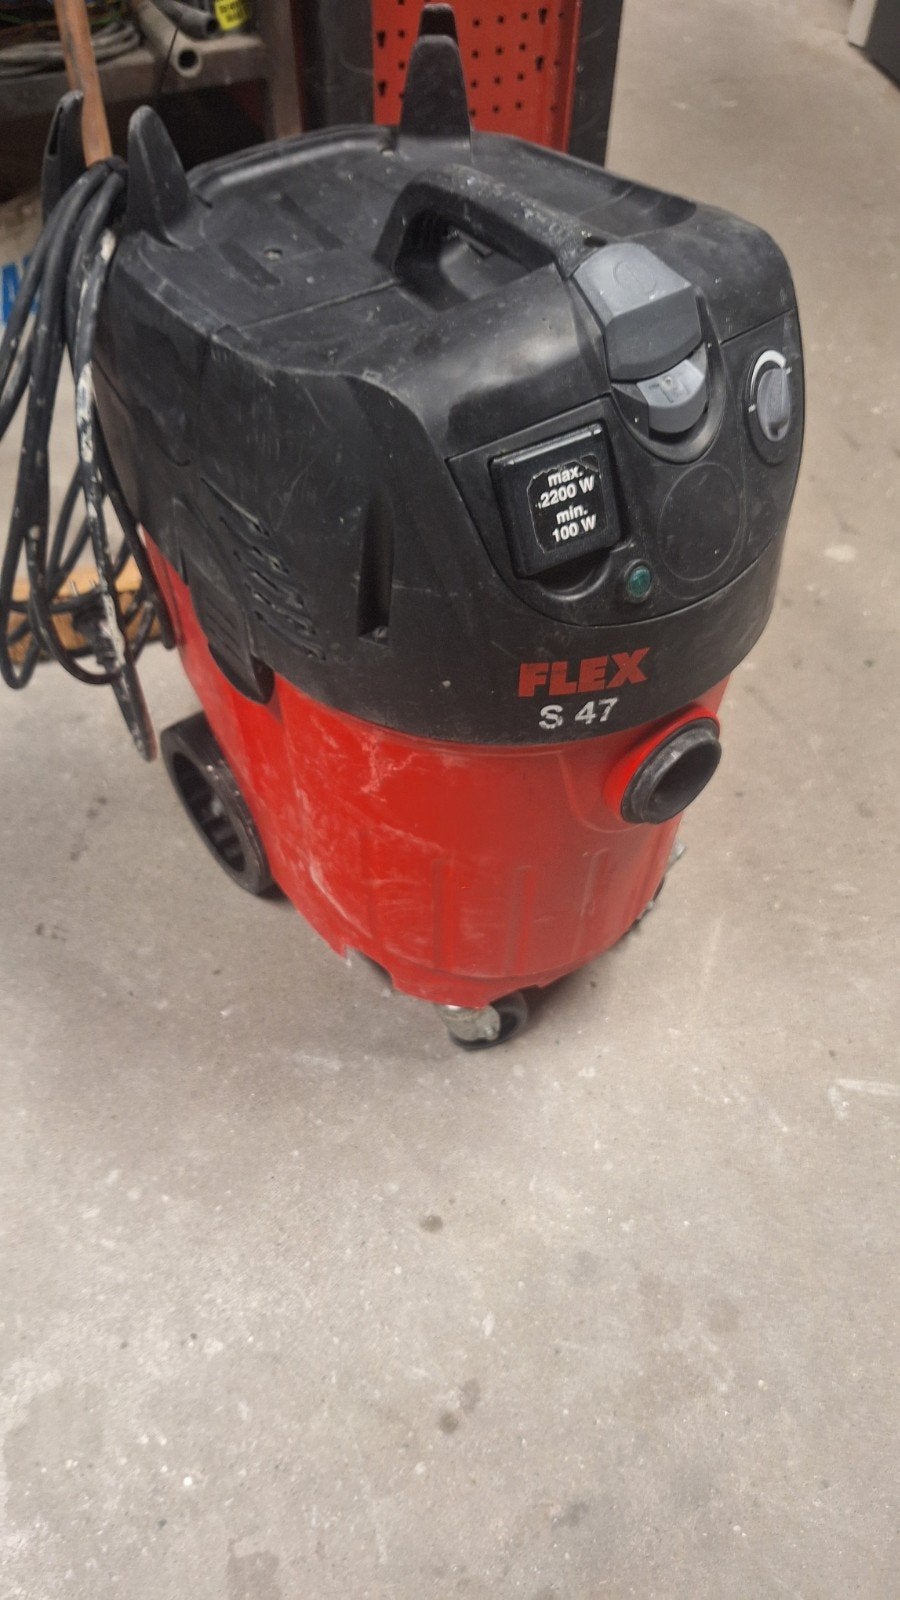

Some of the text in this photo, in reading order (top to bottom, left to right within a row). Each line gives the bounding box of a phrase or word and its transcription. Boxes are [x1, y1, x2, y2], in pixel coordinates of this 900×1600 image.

[547, 465, 584, 487] max.
[540, 475, 595, 508] 2200 W
[552, 514, 597, 542] 100 W
[556, 504, 589, 524] min.
[518, 647, 650, 697] FLEX
[538, 697, 618, 729] S 47
